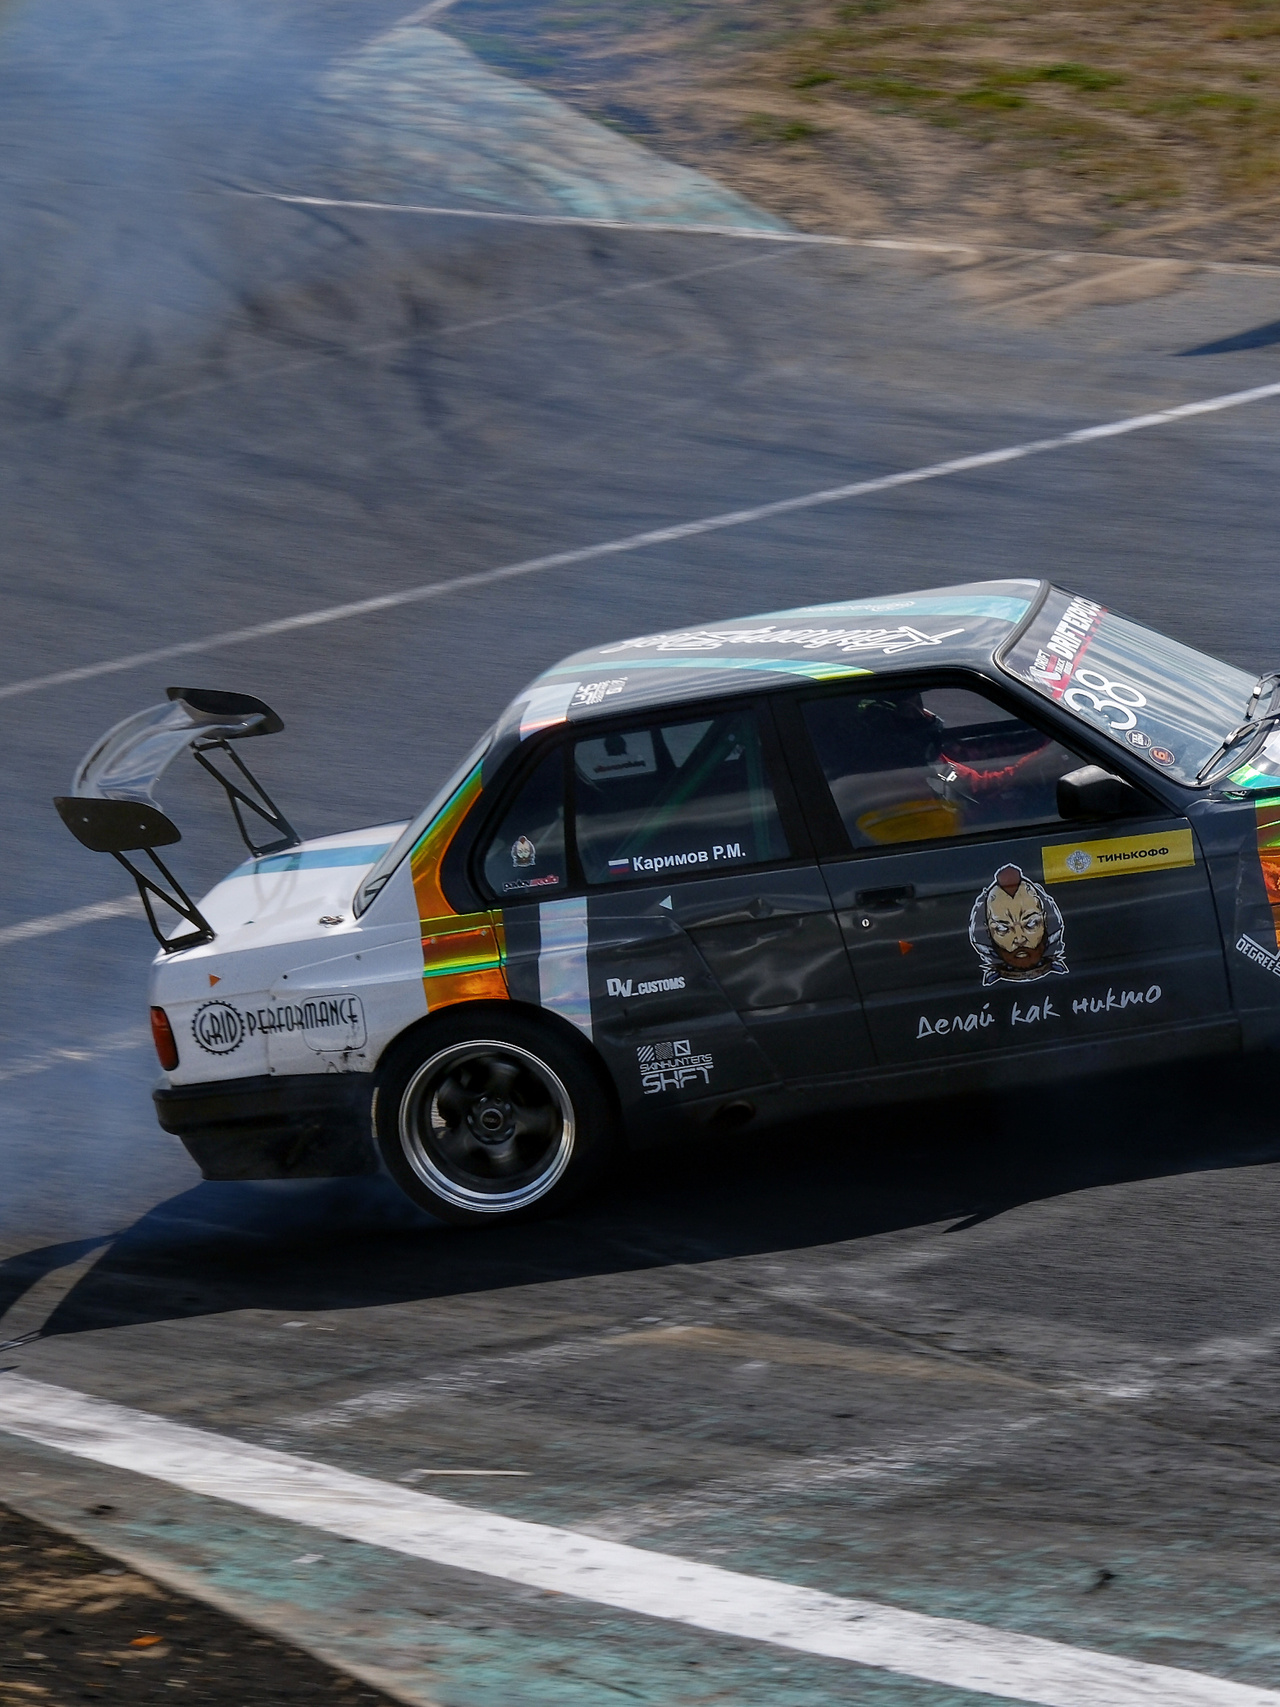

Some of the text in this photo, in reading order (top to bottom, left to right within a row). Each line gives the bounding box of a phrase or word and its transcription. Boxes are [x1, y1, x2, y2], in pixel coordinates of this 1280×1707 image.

[1046, 619, 1086, 661] DRIFT
[1064, 668, 1147, 730] 38
[632, 843, 746, 872] Каримов Р.М.
[1096, 846, 1169, 863] ТИНЬКОФФ
[1235, 937, 1276, 970] DEGREE
[199, 998, 358, 1046] GRID PERFORMANCE
[916, 985, 1162, 1039] Делай как никто
